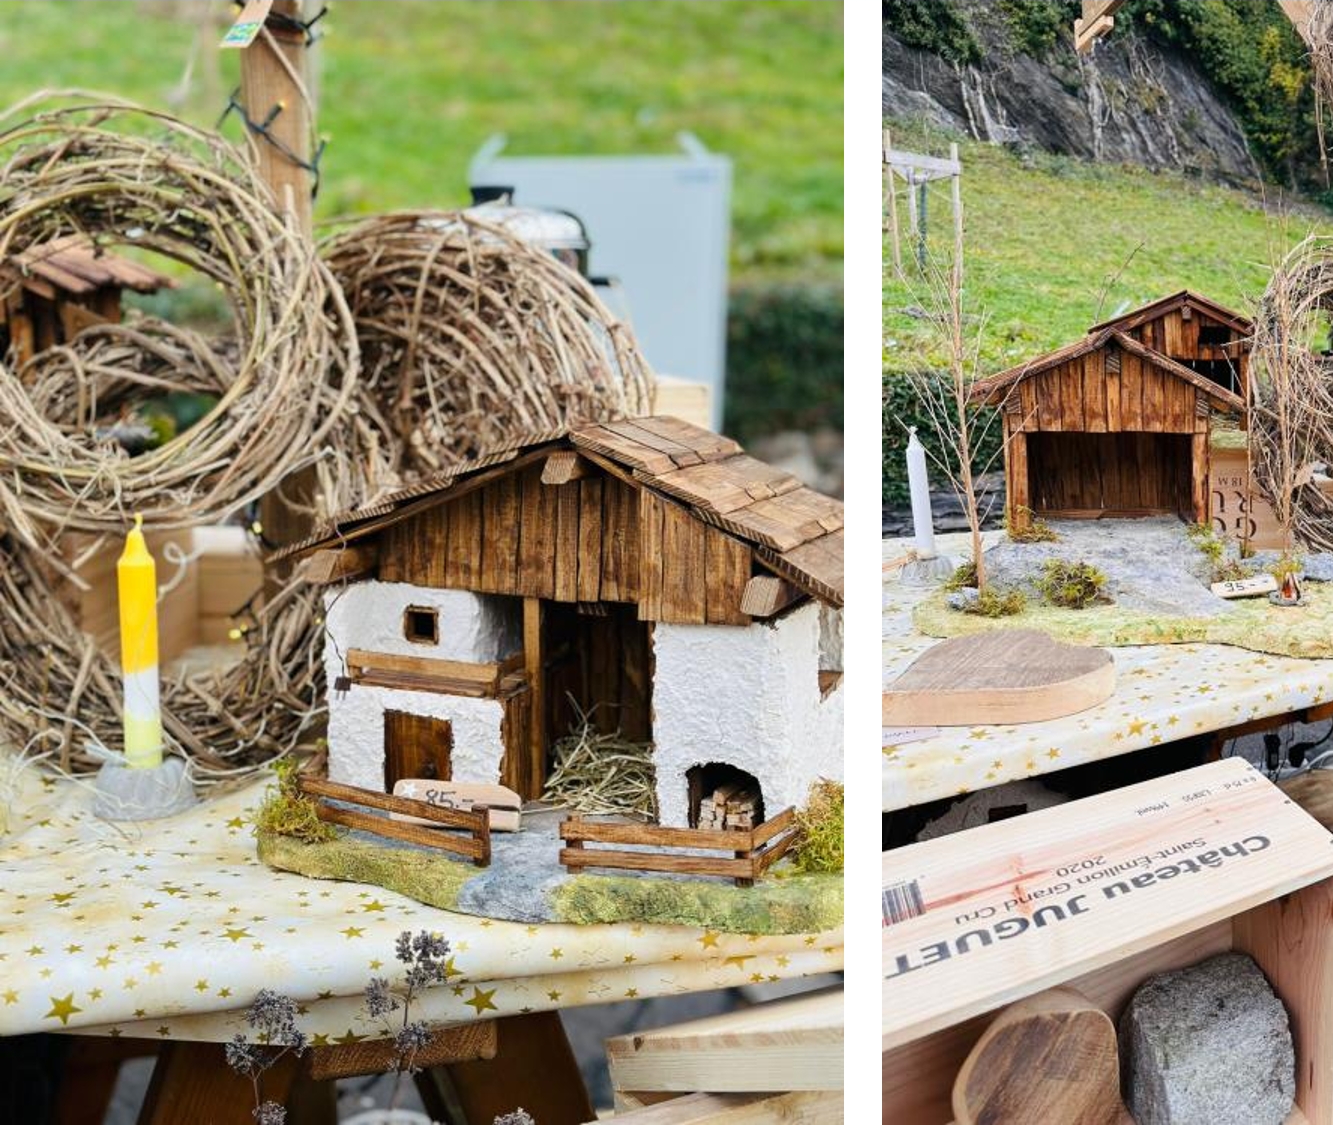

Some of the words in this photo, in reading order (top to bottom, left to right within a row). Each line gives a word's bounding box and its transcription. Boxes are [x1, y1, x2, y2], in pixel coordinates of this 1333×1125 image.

[1056, 854, 1106, 878] 2020
[1080, 837, 1206, 888] Saint-Émilion
[1103, 834, 1271, 901] Château
[954, 906, 997, 926] Cru
[1003, 879, 1071, 913] Grand
[884, 903, 1091, 980] JUGUET
